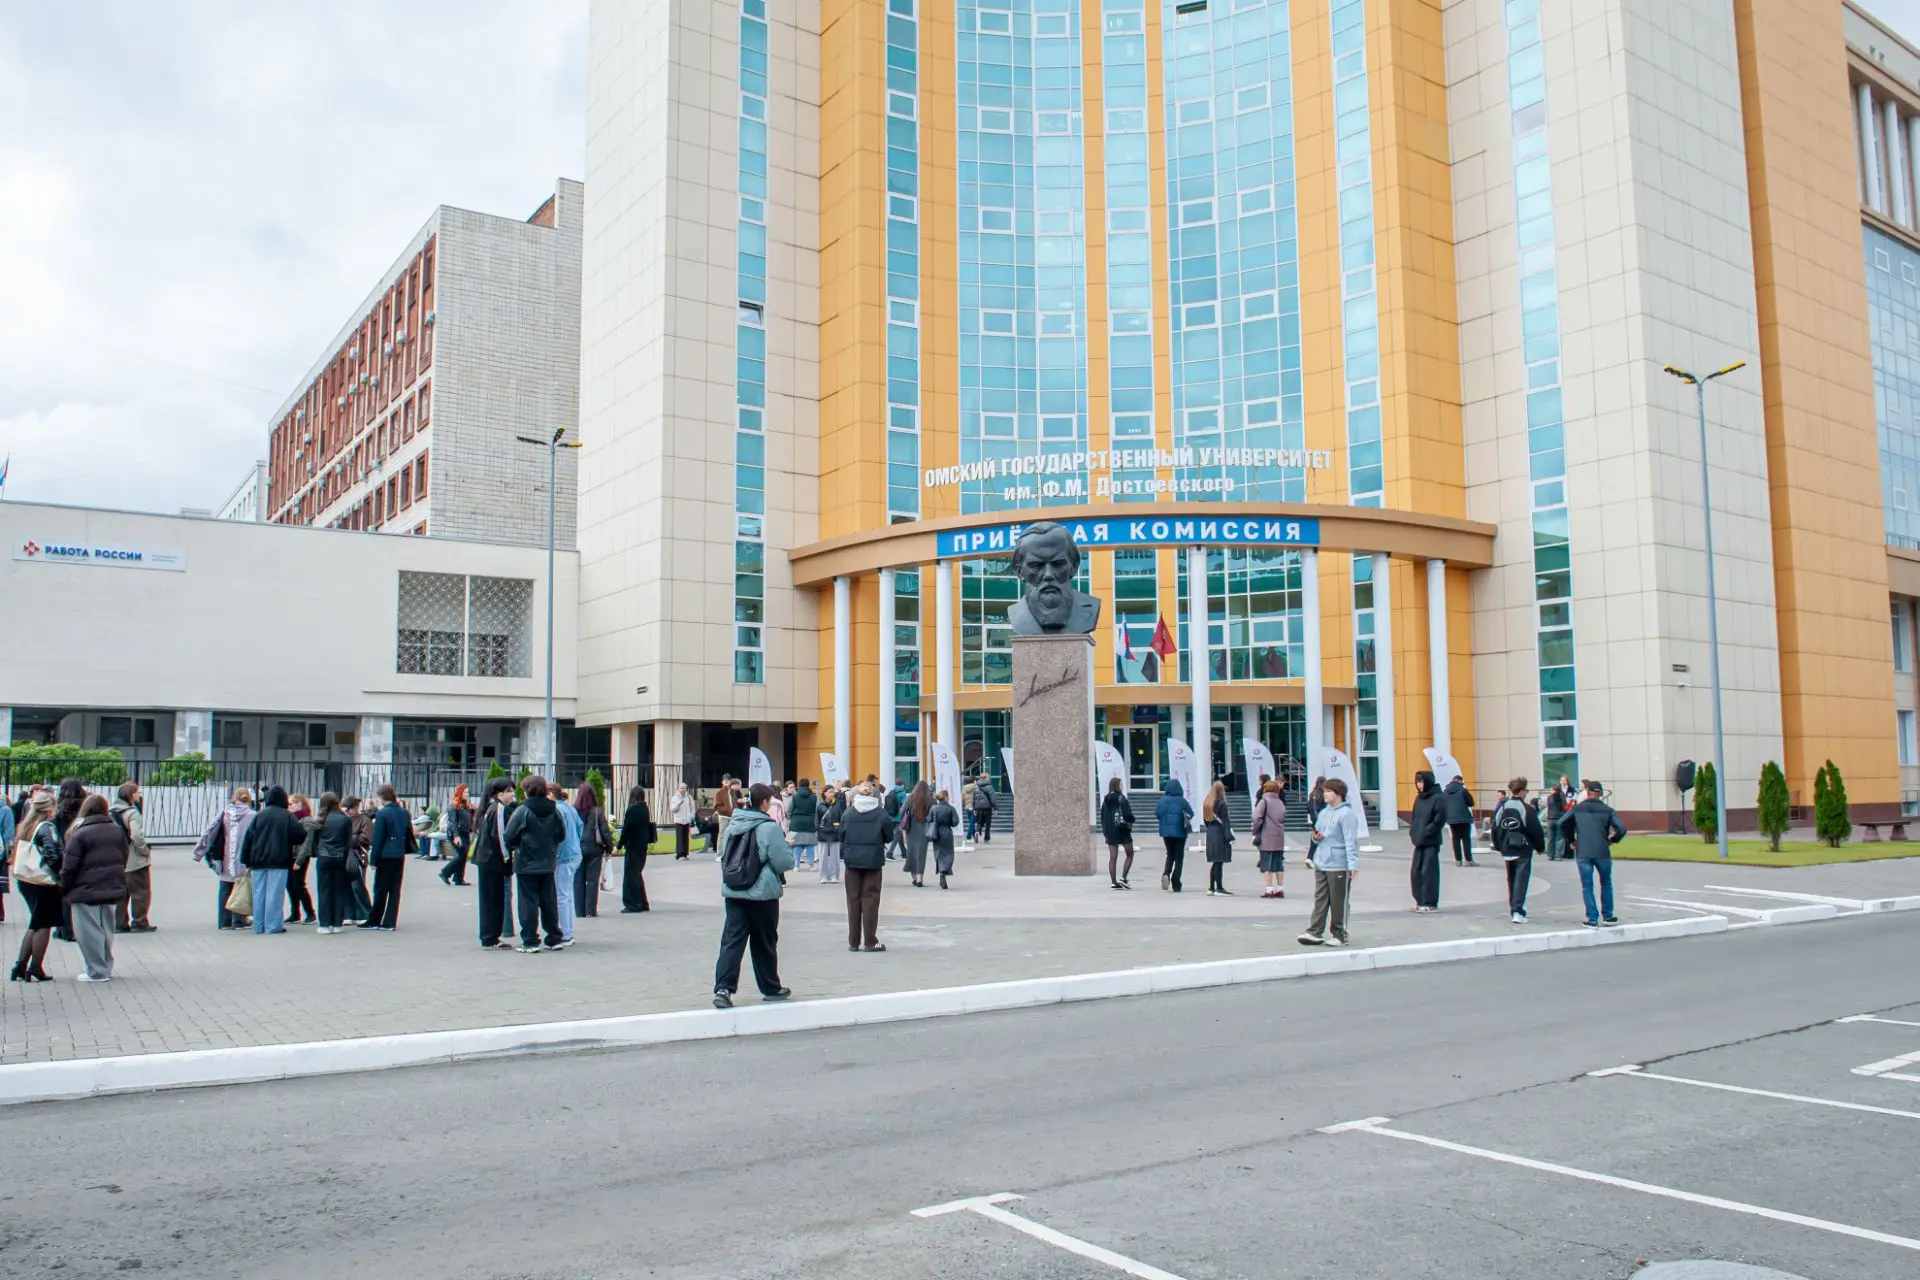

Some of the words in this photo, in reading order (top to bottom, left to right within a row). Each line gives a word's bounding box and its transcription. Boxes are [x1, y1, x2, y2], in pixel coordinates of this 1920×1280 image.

[925, 456, 996, 488] ОМСКИЙ
[1001, 444, 1193, 477] ГОСУДАРСТВЕННЫЙ
[1198, 447, 1331, 469] УНИВЕРСИТЕТ
[1003, 486, 1037, 501] им.
[1043, 479, 1087, 498] Ф.М.
[1096, 476, 1235, 497] Достоевского
[953, 522, 1109, 553] ПРИЁАЯ
[1129, 521, 1301, 541] КОМИССИЯ
[44, 545, 90, 557] РАБОТА
[94, 549, 143, 561] РОССИИ
